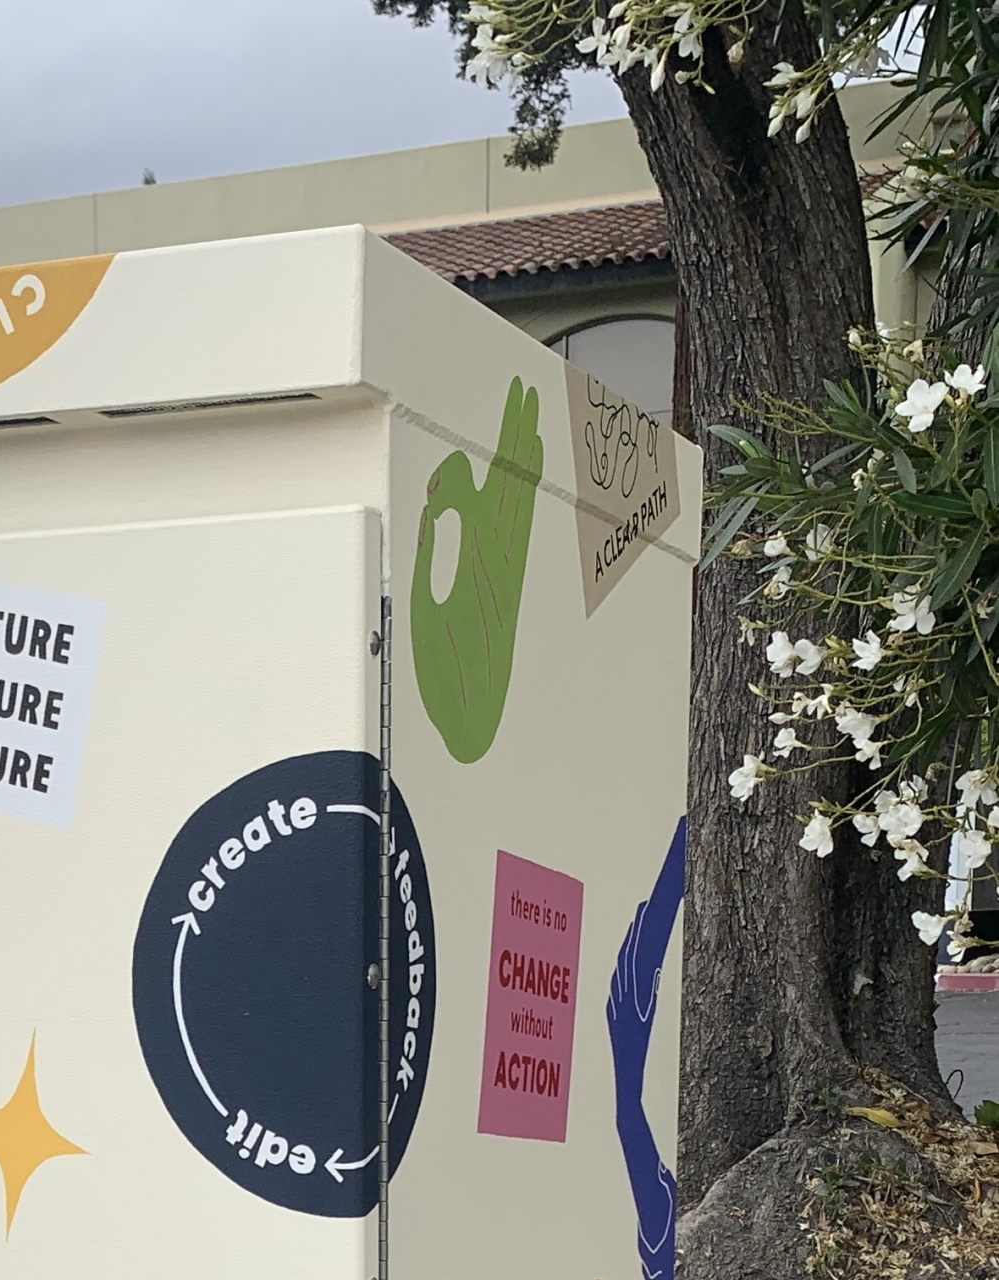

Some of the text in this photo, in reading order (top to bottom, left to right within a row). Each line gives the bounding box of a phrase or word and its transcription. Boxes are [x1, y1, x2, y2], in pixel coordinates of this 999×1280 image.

[595, 481, 668, 583] A CLEAR PATH
[188, 797, 318, 912] create
[511, 890, 567, 932] there is no
[394, 849, 425, 1092] feedback
[499, 950, 570, 1003] CHANGE
[511, 1008, 553, 1040] without
[494, 1051, 560, 1098] ACTION
[225, 1109, 316, 1174] edit
